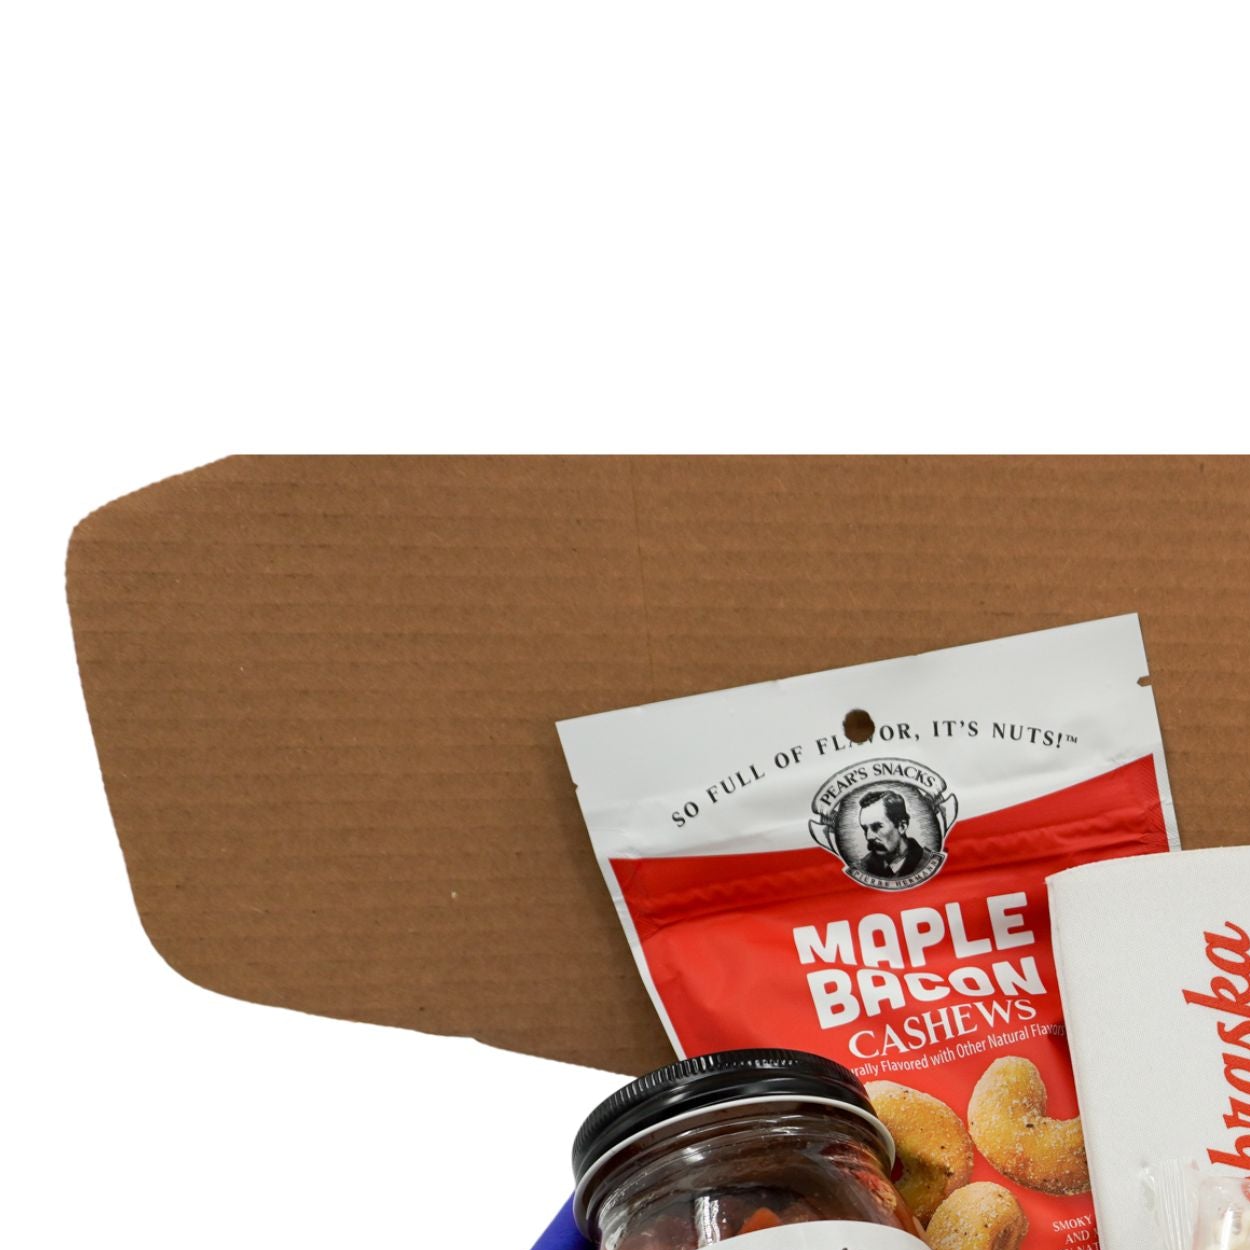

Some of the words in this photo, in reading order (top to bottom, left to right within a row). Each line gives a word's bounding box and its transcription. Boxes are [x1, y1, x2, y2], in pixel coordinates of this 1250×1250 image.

[671, 801, 699, 828] SO
[706, 764, 766, 804] FULL
[774, 745, 803, 769] OF
[815, 723, 919, 755] FLOR,
[933, 721, 978, 737] IT'S
[820, 767, 868, 806] PEAR'S
[872, 763, 936, 788] SNACKS
[792, 891, 1035, 969] MAPLE
[806, 956, 1047, 1030] BACON
[848, 999, 1037, 1059] CASHEWS
[881, 1057, 928, 1073] Flavored
[929, 1048, 956, 1065] with
[957, 1040, 987, 1058] Other
[987, 1026, 1029, 1048] Natural
[1052, 1214, 1092, 1232] SMOKY
[1065, 1230, 1090, 1245] AND
